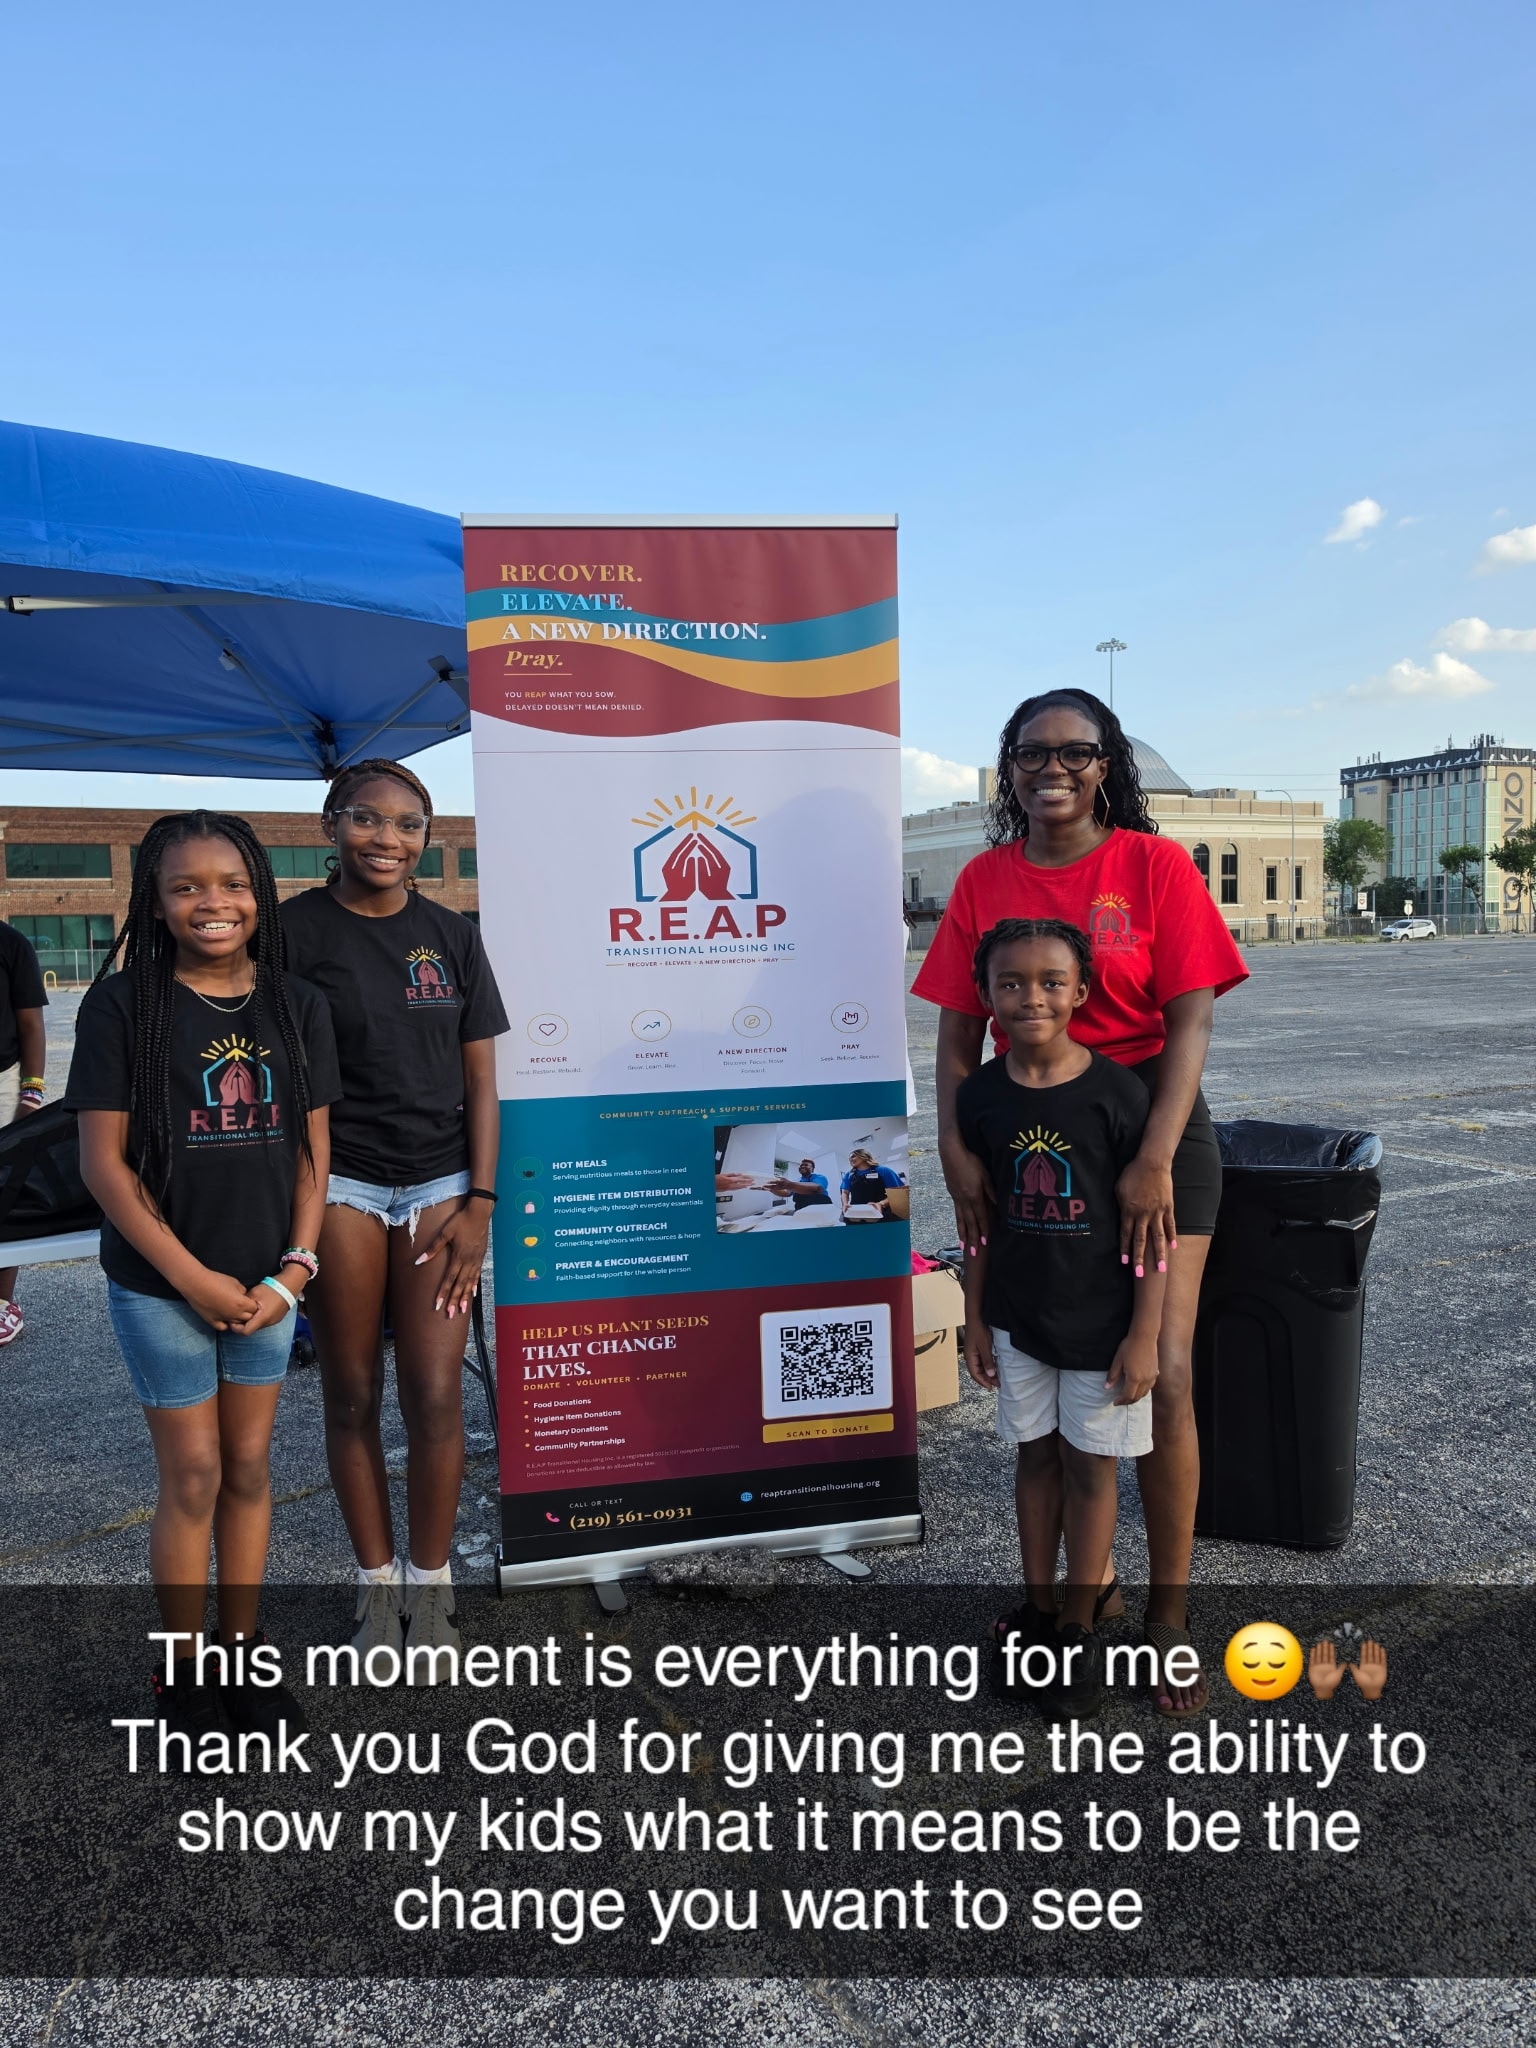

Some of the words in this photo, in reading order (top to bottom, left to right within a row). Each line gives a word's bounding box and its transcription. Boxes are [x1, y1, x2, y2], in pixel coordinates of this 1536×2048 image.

[500, 564, 643, 582] RECOVER.
[501, 593, 633, 611] ELEVATE.
[501, 622, 520, 640] A
[529, 622, 593, 640] NEW
[602, 622, 767, 640] DIRECTION.
[504, 651, 563, 669] Pray.
[505, 703, 543, 711] DELAYED
[545, 703, 582, 711] DOESN'T
[585, 703, 608, 711] MEAN
[610, 703, 644, 711] DENIED.
[1503, 772, 1523, 914] LONZO
[609, 904, 787, 942] R.E.A.P
[606, 946, 704, 956] TRANSITIONAL
[709, 944, 768, 953] HOUSING
[774, 943, 795, 951] INC
[406, 986, 454, 999] R.E.A.P
[600, 1110, 655, 1119] COMMUNITY
[658, 1108, 707, 1116] OUTREACH
[719, 1106, 761, 1114] SUPPORT
[764, 1103, 807, 1112] SERVICES
[187, 1133, 247, 1141] TRANSITIONAL
[552, 1161, 573, 1169] HOT
[575, 1159, 607, 1168] MEALS
[553, 1173, 579, 1182] Serving
[579, 1170, 612, 1179] nutritious
[614, 1169, 633, 1177] meals
[670, 1166, 687, 1174] need
[553, 1193, 595, 1204] HYGIENE
[598, 1191, 620, 1201] ITEM
[623, 1187, 692, 1199] DISTRIBUTION
[554, 1206, 587, 1215] Providing
[587, 1204, 610, 1213] dignity
[612, 1203, 638, 1212] through
[639, 1202, 670, 1210] everyday
[672, 1199, 704, 1208] essentials
[554, 1225, 613, 1237] COMMUNITY
[615, 1222, 667, 1233] OUTREACH
[555, 1239, 593, 1249] Connecting
[595, 1237, 627, 1246] neighbors
[684, 1233, 701, 1241] hope
[556, 1259, 593, 1270] PRAYER
[594, 1259, 602, 1267] &
[604, 1253, 689, 1266] ENCOURAGEMENT
[556, 1272, 595, 1281] Faith-based
[596, 1270, 623, 1279] support
[648, 1267, 667, 1275] whole
[668, 1266, 691, 1275] person
[522, 1326, 569, 1341] HELP
[571, 1323, 593, 1336] US
[598, 1319, 653, 1335] PLANT
[656, 1315, 709, 1330] SEEDS
[522, 1344, 582, 1361] THAT
[587, 1335, 677, 1355] CHANGE
[523, 1361, 592, 1381] LIVES.
[523, 1382, 561, 1391] DONATE
[576, 1376, 631, 1387] VOLUNTEER
[646, 1371, 688, 1381] PARTNER
[533, 1400, 553, 1409] Food
[553, 1397, 592, 1407] Donations
[534, 1414, 564, 1424] Hygiene
[565, 1412, 582, 1421] Item
[584, 1409, 622, 1419] Donations
[534, 1428, 569, 1438] Monetary
[571, 1424, 609, 1434] Donations
[786, 1430, 811, 1439] SCAN
[832, 1424, 870, 1435] DONATE
[535, 1440, 577, 1453] Community
[579, 1436, 626, 1448] Partnerships
[760, 1480, 881, 1498] reaptransitionalhousing.org
[570, 1512, 611, 1531] (219)
[616, 1506, 693, 1526] 561-0931
